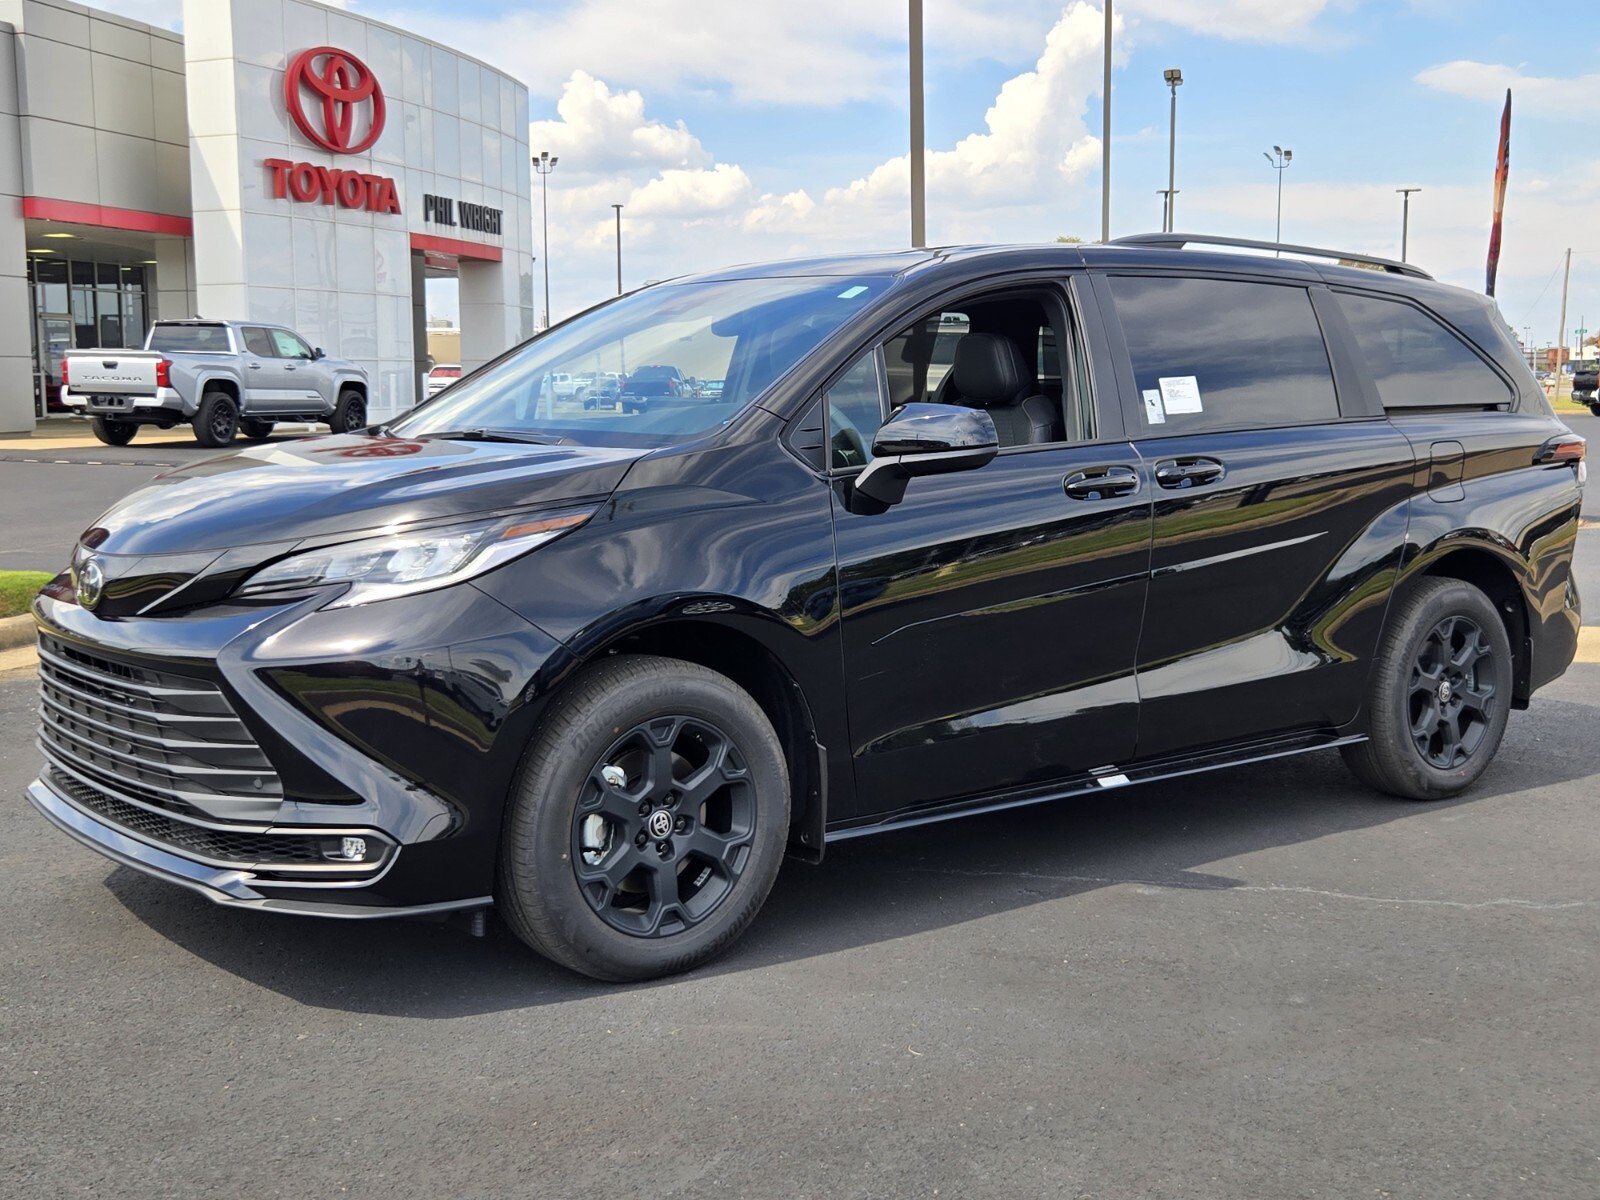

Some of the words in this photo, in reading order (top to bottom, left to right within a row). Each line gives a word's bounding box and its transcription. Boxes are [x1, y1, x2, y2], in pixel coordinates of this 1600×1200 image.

[265, 158, 402, 215] TOYOTA
[423, 193, 457, 226] PHIL
[458, 200, 503, 235] WRIGHT
